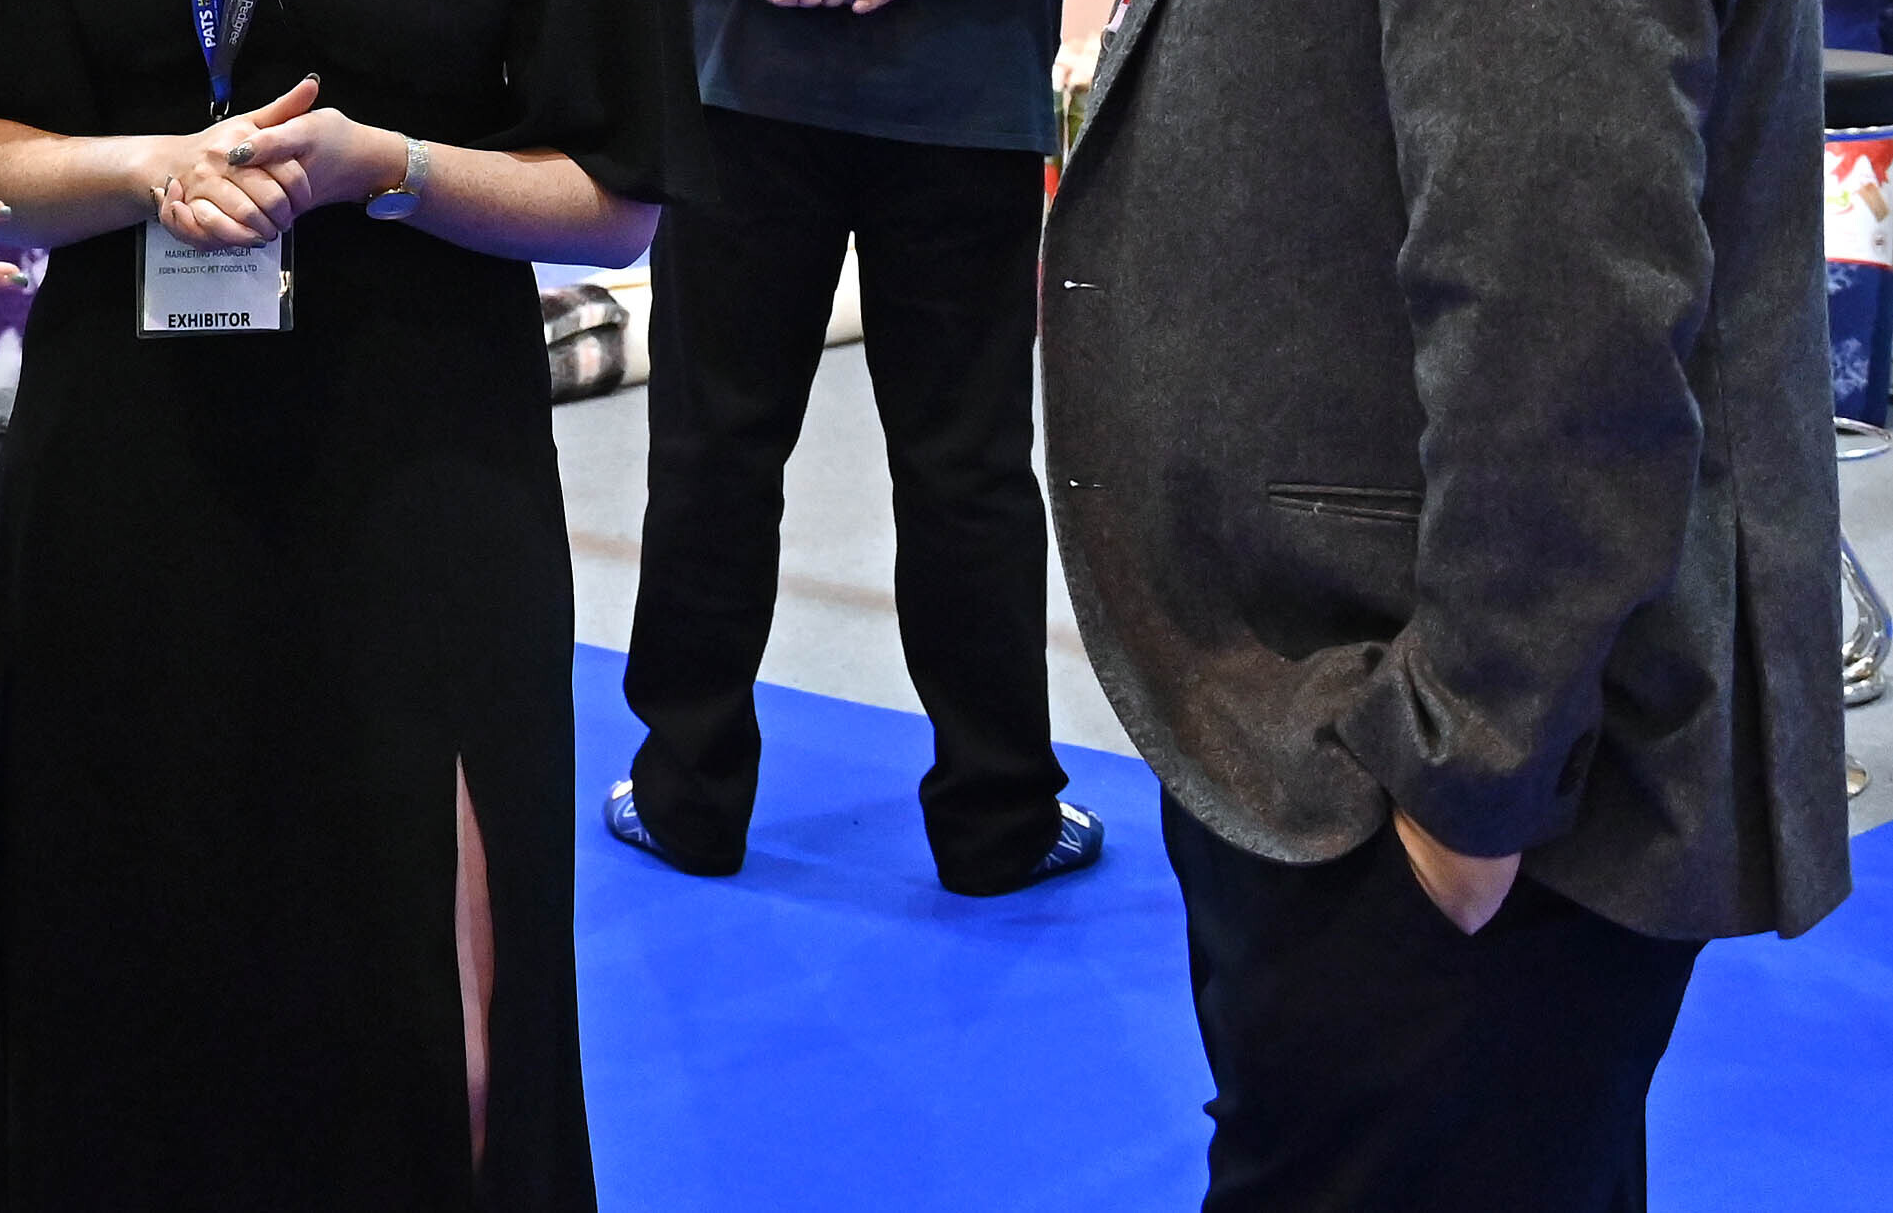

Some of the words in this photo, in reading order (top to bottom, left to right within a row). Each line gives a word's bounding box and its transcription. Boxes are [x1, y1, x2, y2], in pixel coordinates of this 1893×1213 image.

[200, 9, 217, 49] PATS
[229, 0, 254, 46] Pedigree
[208, 264, 219, 274] PET
[244, 264, 258, 273] LTD
[168, 312, 251, 328] EXHIBITOR
